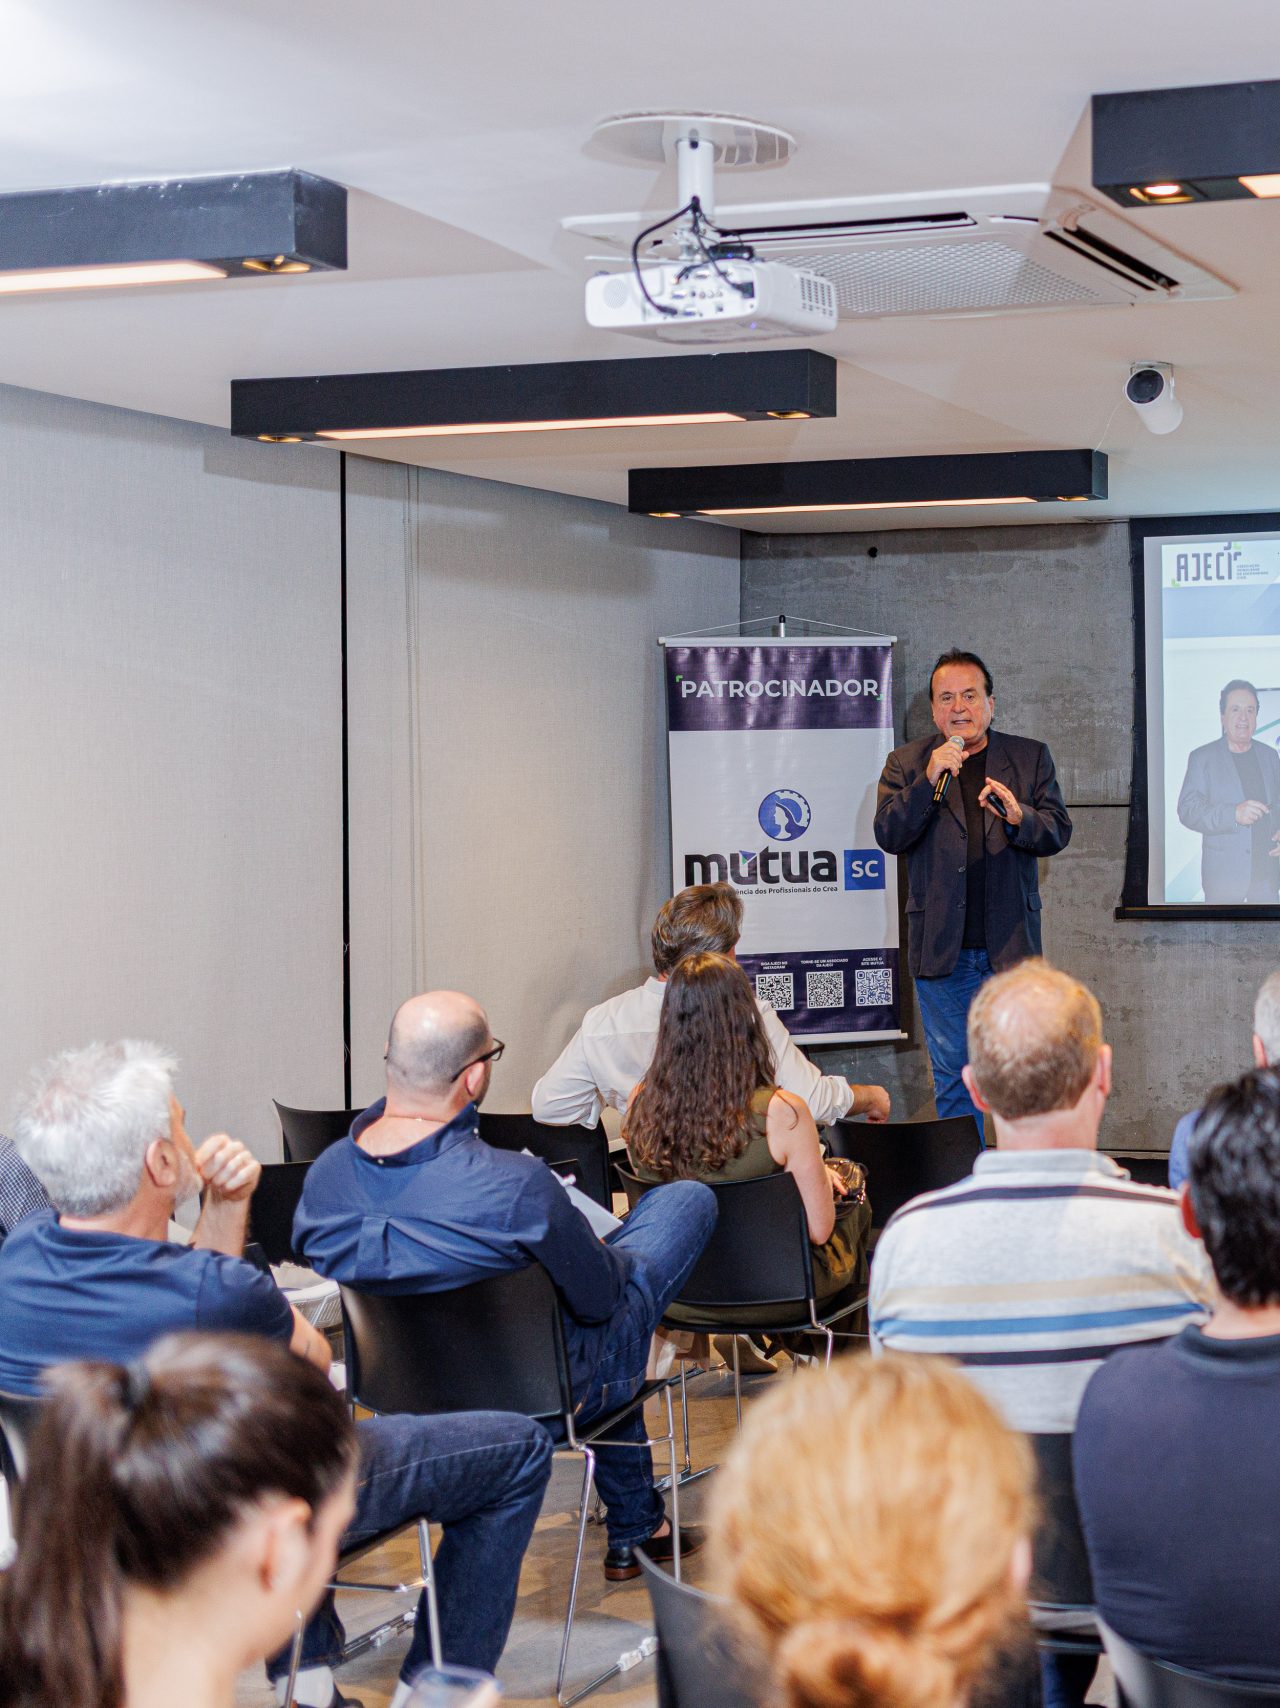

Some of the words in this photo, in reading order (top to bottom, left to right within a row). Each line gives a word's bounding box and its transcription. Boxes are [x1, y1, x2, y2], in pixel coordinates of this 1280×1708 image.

[681, 679, 879, 698] PATROCINADOR
[851, 860, 879, 878] SC
[768, 886, 811, 895] Profissionais
